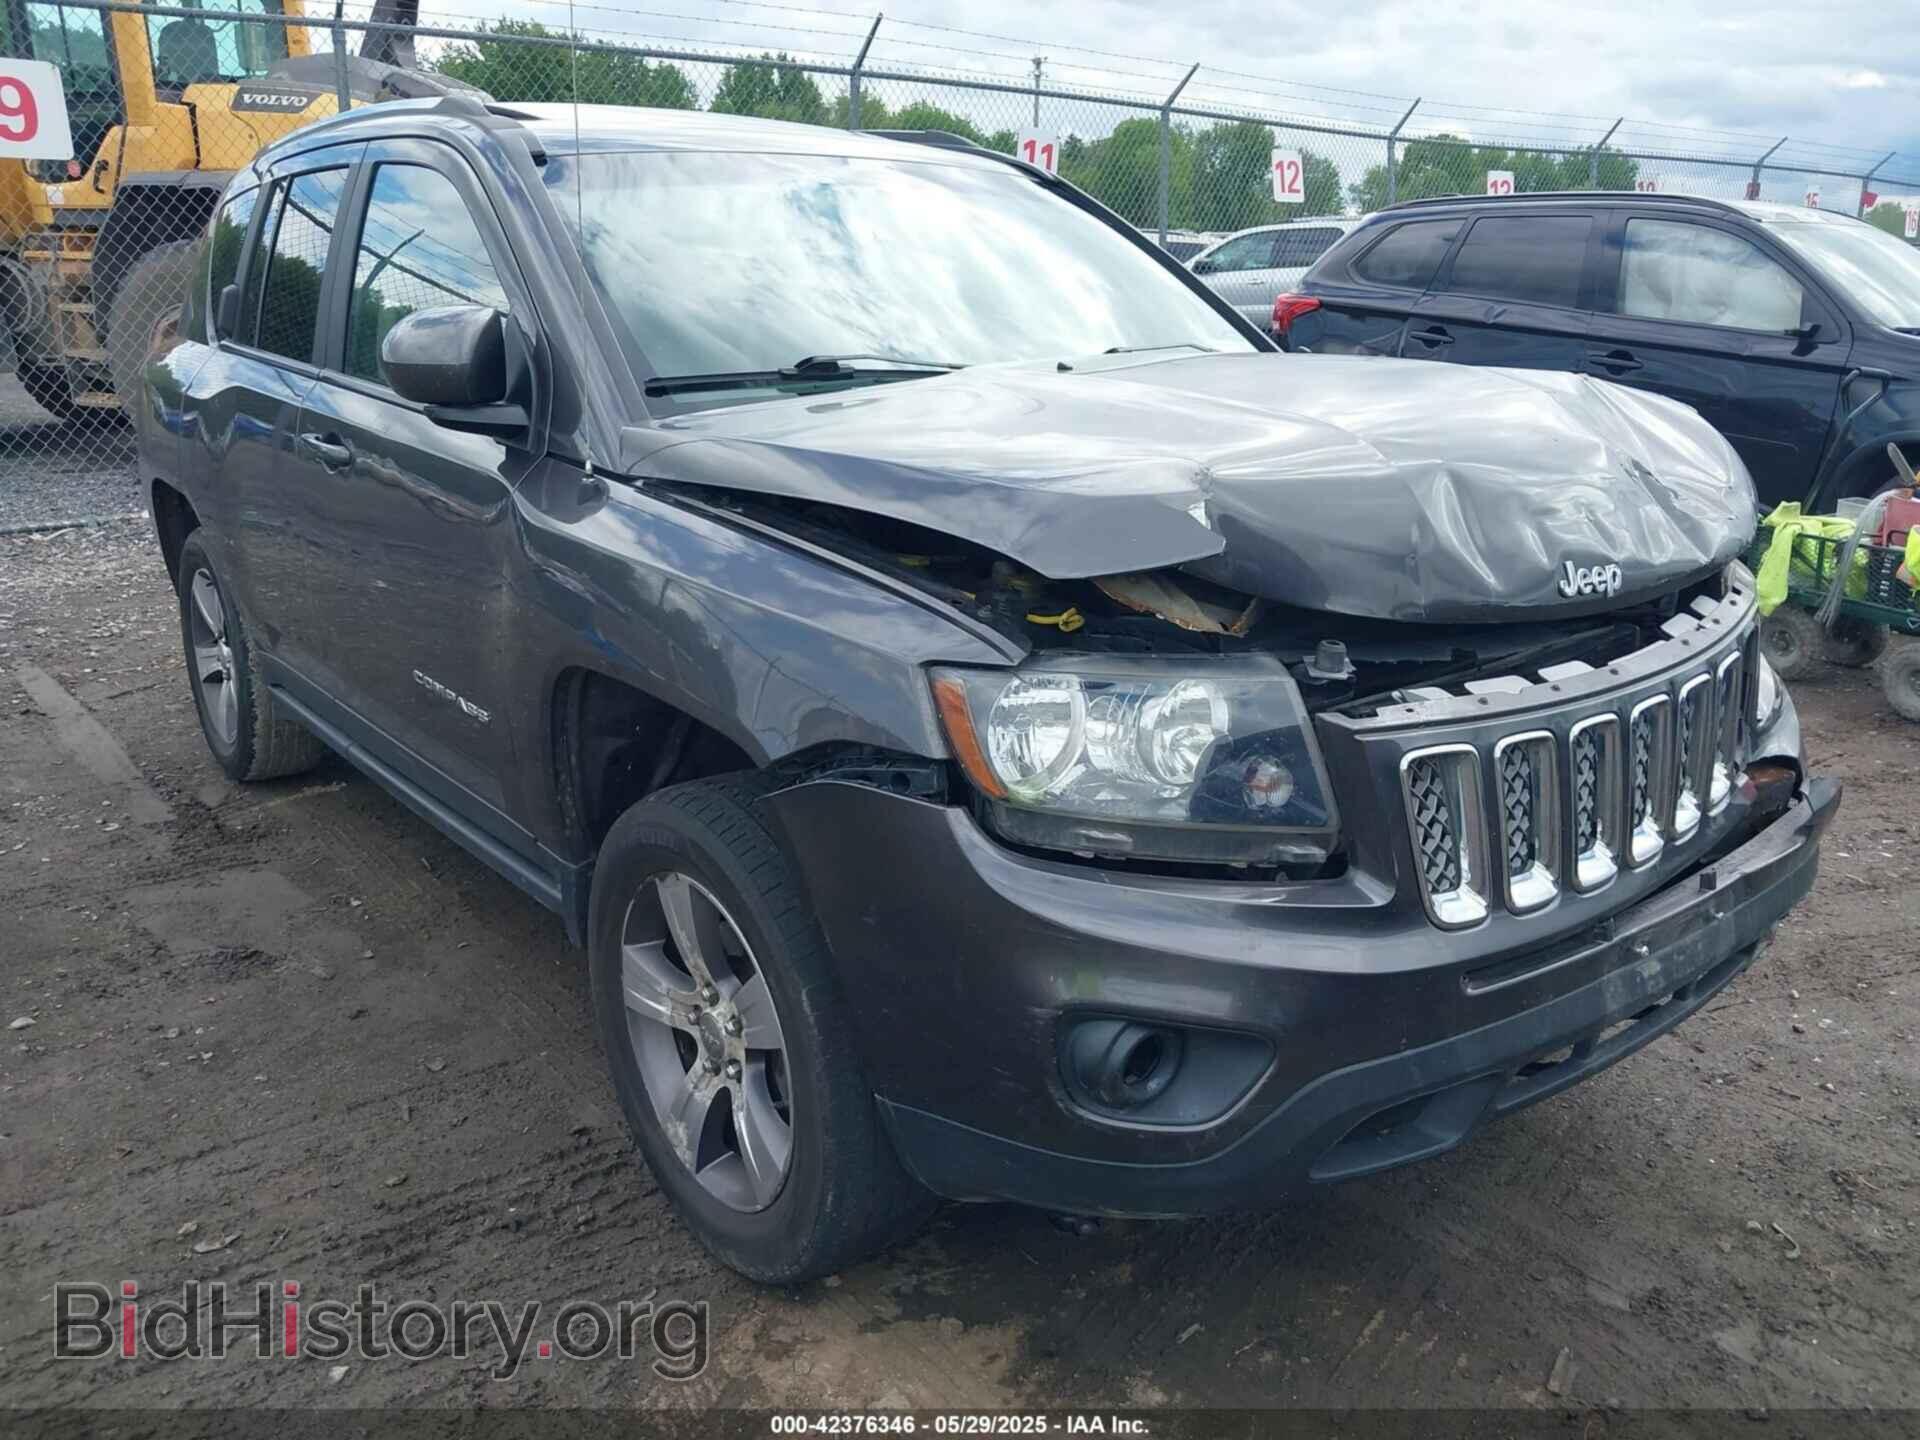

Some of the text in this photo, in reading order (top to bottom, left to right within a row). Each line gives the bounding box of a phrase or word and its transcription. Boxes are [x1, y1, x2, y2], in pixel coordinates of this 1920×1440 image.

[0, 76, 38, 141] 9
[242, 94, 307, 106] VOLVO
[1024, 140, 1053, 170] 11
[1275, 160, 1301, 193] 12
[1560, 560, 1622, 597] Jeep
